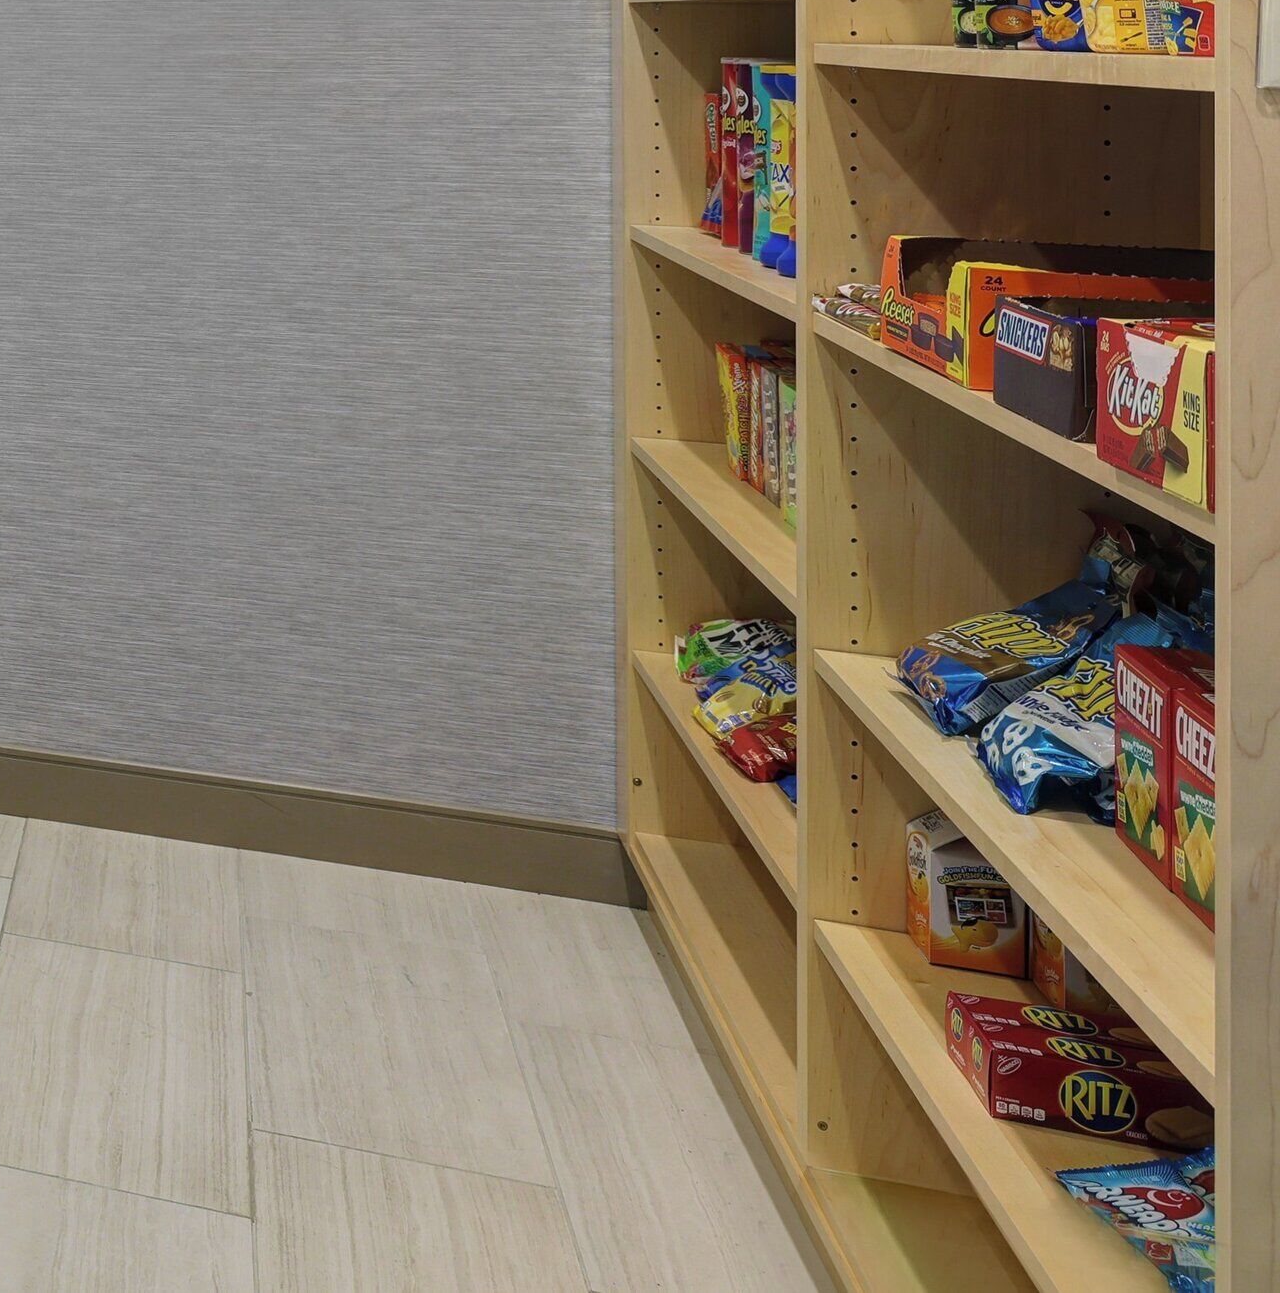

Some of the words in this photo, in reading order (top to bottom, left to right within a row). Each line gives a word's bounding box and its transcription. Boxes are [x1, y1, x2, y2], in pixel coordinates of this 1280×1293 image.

[985, 276, 1003, 286] 24
[881, 286, 915, 325] Reese's
[949, 292, 962, 306] KING
[949, 304, 961, 318] SIZE
[997, 310, 1048, 358] SNICKERS
[1102, 330, 1110, 342] 24
[1182, 390, 1201, 412] KING
[740, 415, 750, 442] PATCH
[1183, 410, 1200, 432] SIZE
[1132, 742, 1154, 766] cheddar
[942, 866, 960, 874] JOIN
[1030, 1007, 1098, 1032] RITZ
[1050, 1038, 1121, 1062] RITZ
[998, 1059, 1020, 1074] NABISCO
[1064, 1075, 1132, 1121] RITZ
[1125, 1131, 1148, 1141] CRACKERS
